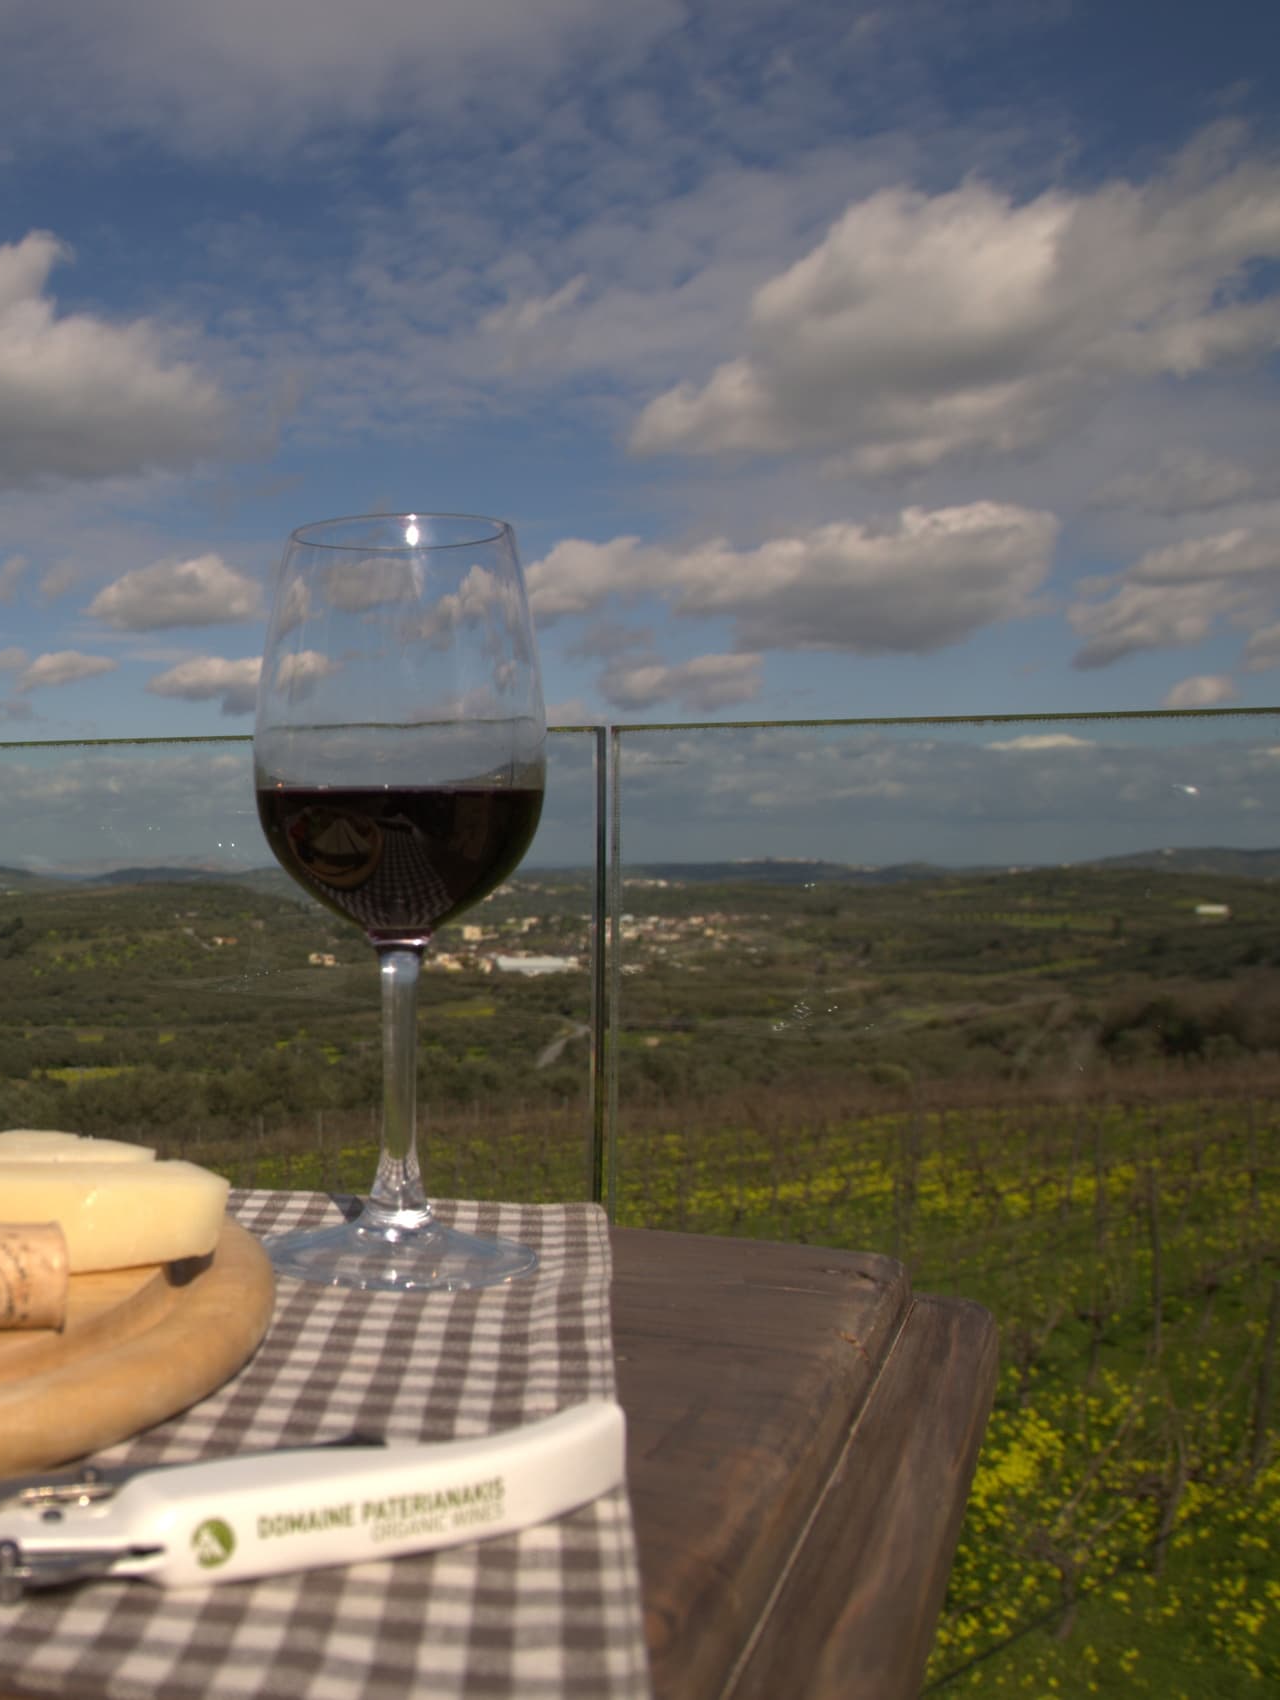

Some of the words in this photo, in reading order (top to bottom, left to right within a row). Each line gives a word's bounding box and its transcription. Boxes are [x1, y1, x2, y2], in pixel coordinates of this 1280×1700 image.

[257, 1502, 354, 1539] DOMAINE
[361, 1476, 505, 1523] PATERIANAKIS
[371, 1517, 447, 1543] ORGANIC
[452, 1502, 505, 1529] WINES
